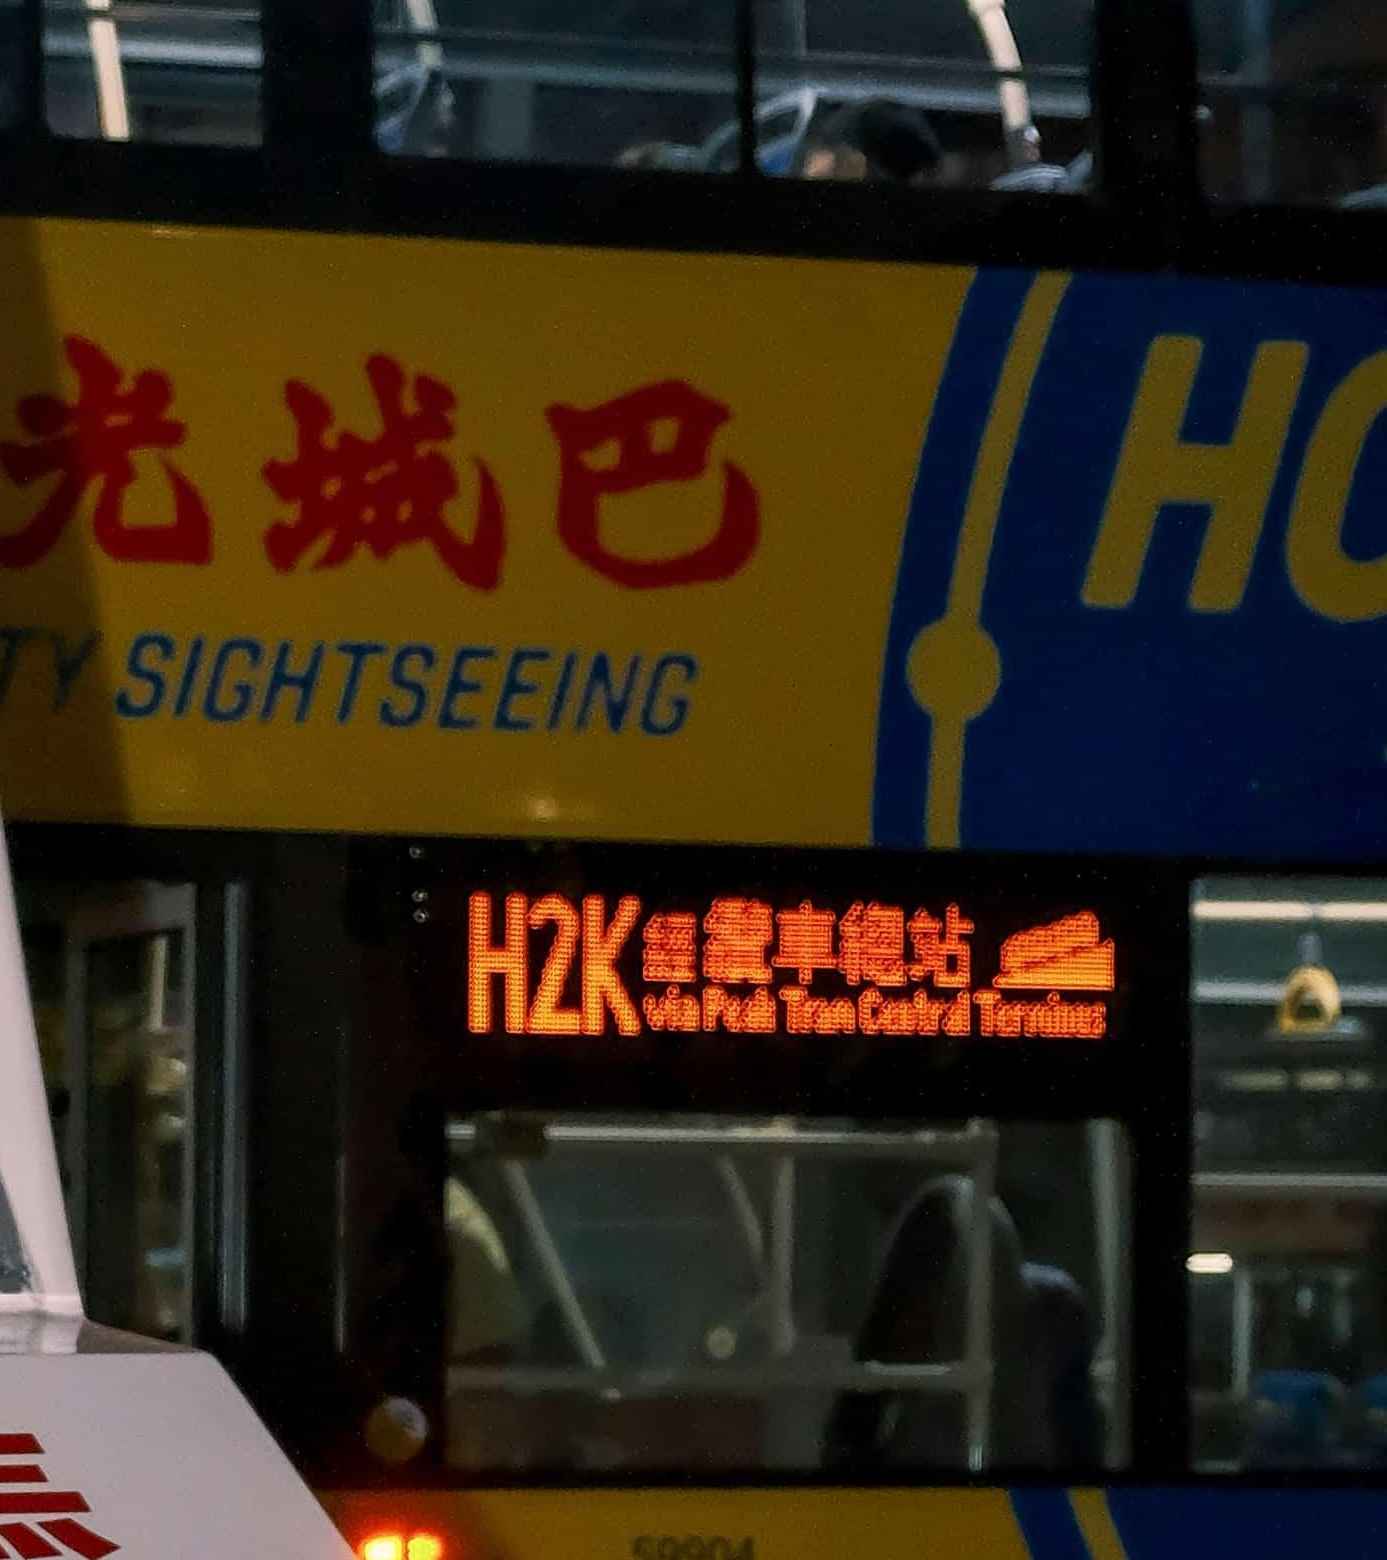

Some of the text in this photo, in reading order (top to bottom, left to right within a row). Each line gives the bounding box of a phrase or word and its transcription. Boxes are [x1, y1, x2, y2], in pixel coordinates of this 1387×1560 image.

[115, 630, 697, 736] SIGHTSEEING
[467, 890, 642, 1037] H2K
[641, 986, 700, 1033] via
